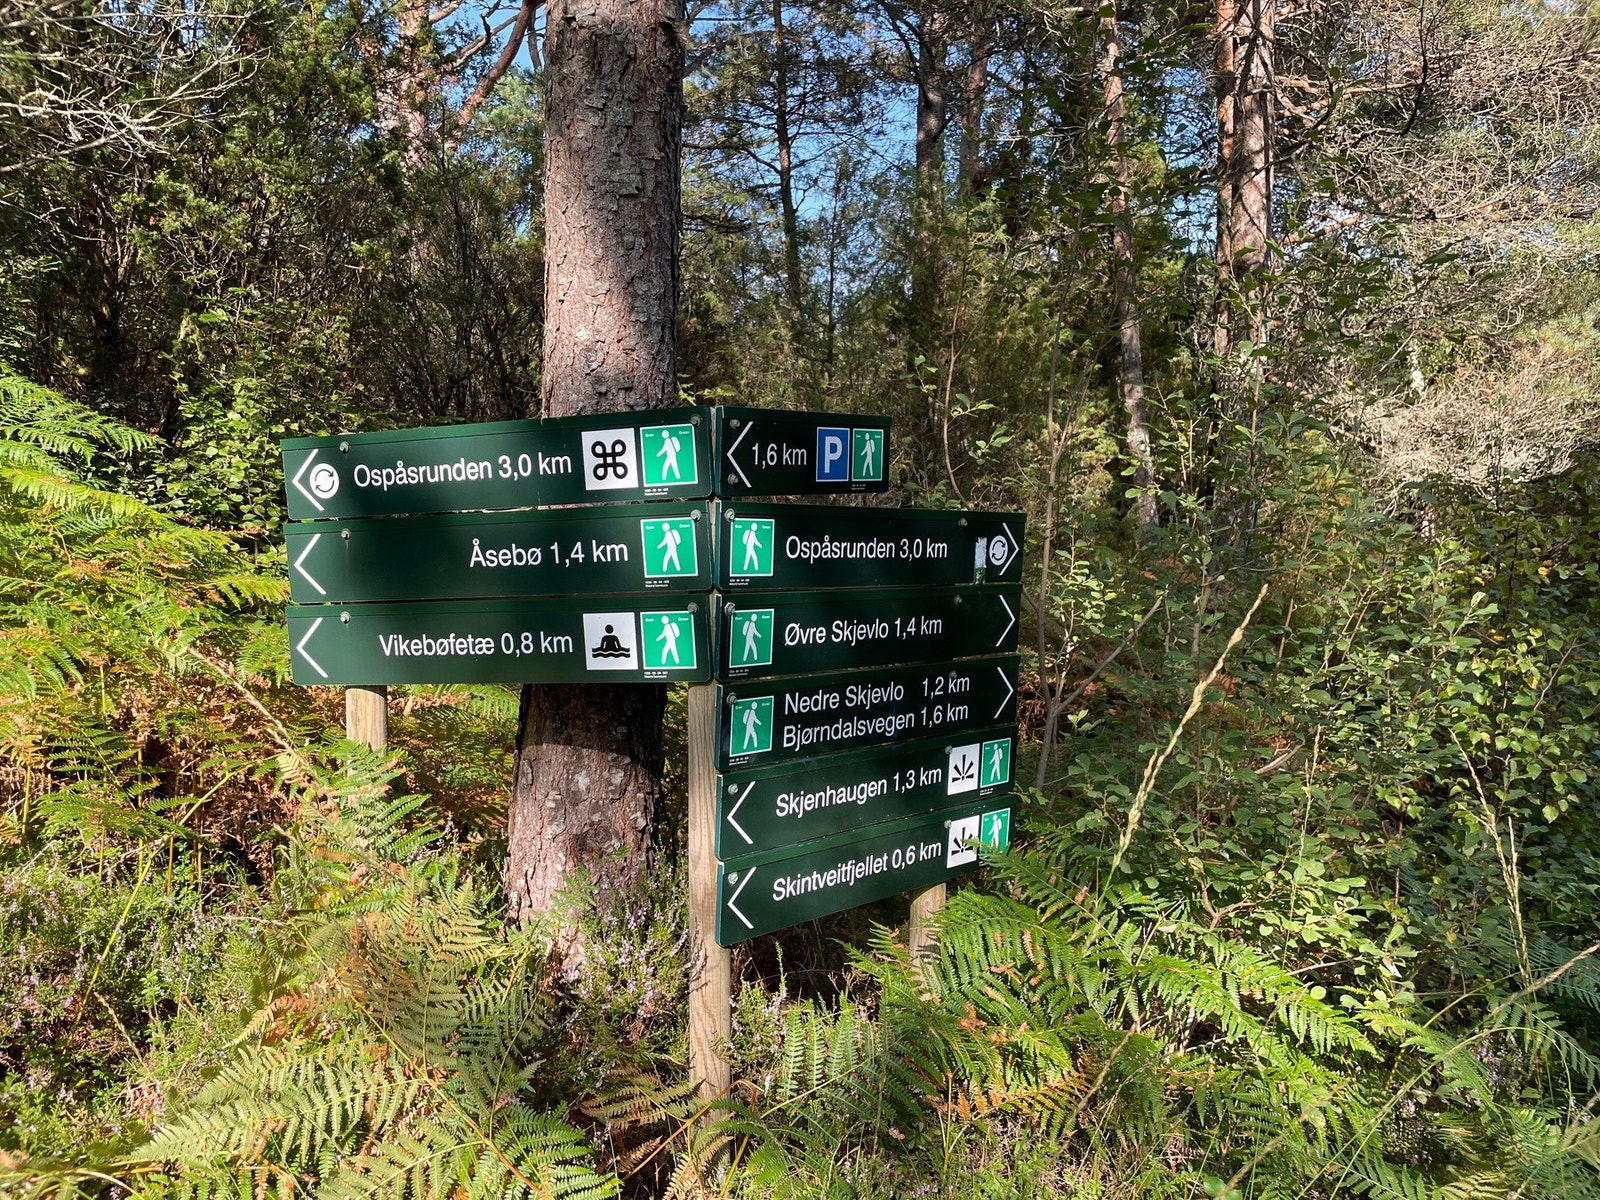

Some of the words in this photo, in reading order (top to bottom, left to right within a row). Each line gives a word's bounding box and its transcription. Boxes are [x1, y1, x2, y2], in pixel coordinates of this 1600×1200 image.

[354, 458, 492, 491] Ospåsrunden
[498, 454, 531, 480] 3,0
[538, 452, 571, 475] km
[752, 443, 777, 469] 1,6
[783, 443, 806, 465] km
[825, 436, 842, 473] P
[470, 538, 541, 567] Åsebø
[550, 542, 584, 567] 1,4
[592, 540, 628, 562] km
[786, 535, 894, 564] Ospåsrunden
[900, 539, 922, 561] 3,0
[927, 538, 947, 557] km
[379, 633, 494, 656] Vikebøfetæ
[501, 632, 533, 657] 0,8
[541, 631, 572, 653] km
[785, 623, 826, 645] Øvre
[832, 619, 888, 646] Skjevlo
[895, 617, 916, 639] 1,4
[921, 616, 941, 635] km
[785, 690, 839, 714] Nedre
[846, 682, 903, 709] Skjevlo
[923, 677, 944, 698] 1,2
[949, 676, 969, 693] km
[783, 712, 914, 752] Bjørndalsvegen
[921, 705, 942, 727] 1,6
[947, 703, 968, 721] km
[776, 780, 887, 818] Skjenhaugen
[894, 770, 915, 793] 1,3
[920, 767, 941, 786] km
[773, 853, 888, 901] Skintveitfjellet
[892, 846, 915, 869] 0,6
[920, 843, 941, 861] km
